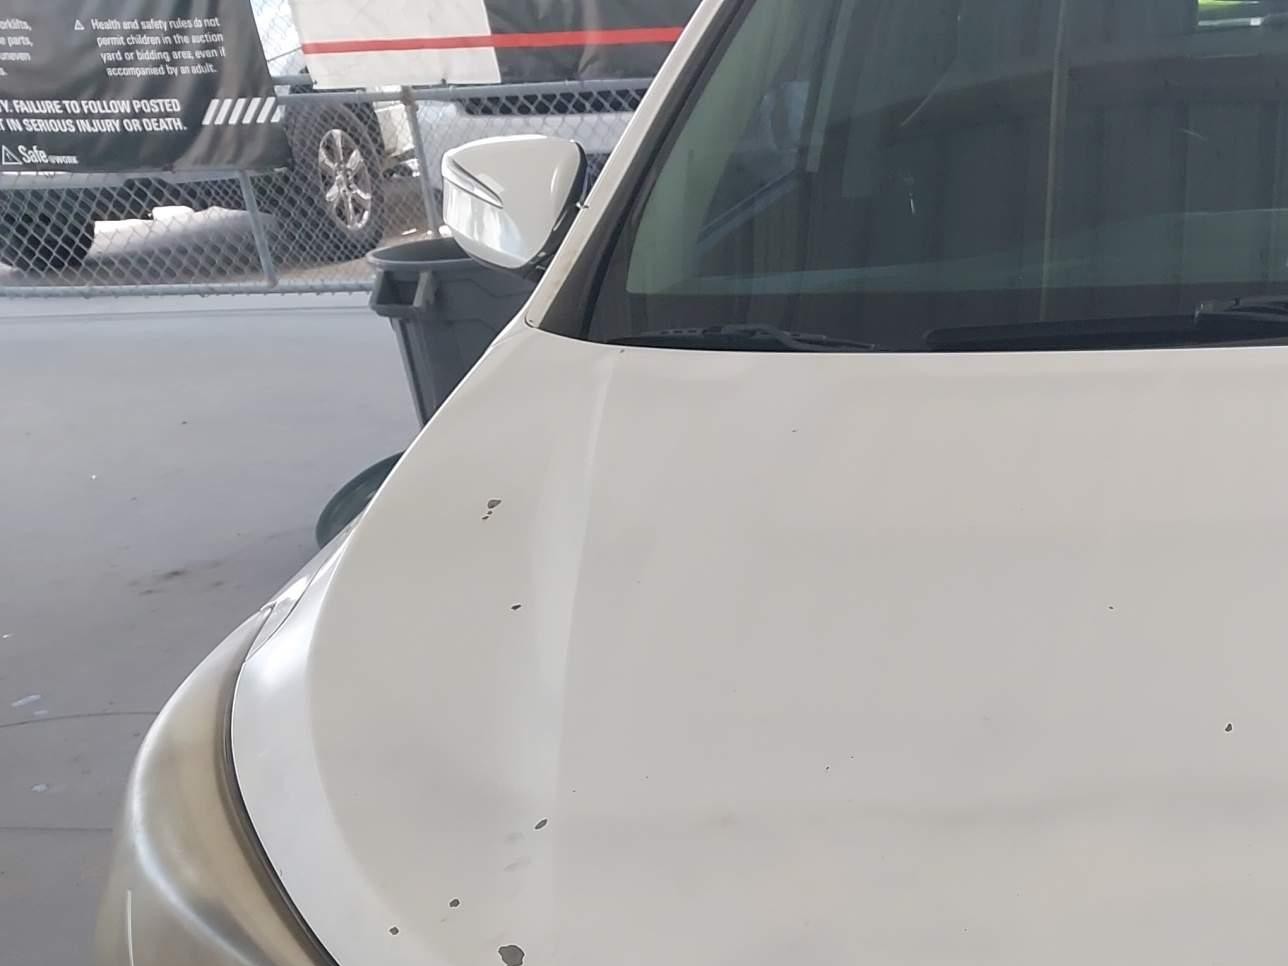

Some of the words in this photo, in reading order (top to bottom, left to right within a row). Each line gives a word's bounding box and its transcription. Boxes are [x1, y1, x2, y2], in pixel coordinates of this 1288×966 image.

[91, 18, 120, 30] Health
[122, 19, 139, 30] and
[141, 19, 167, 31] safety
[169, 17, 192, 29] rules
[193, 17, 202, 28] do
[203, 17, 220, 27] not
[8, 36, 34, 47] parts,
[96, 35, 126, 48] permit
[126, 34, 161, 46] children
[162, 34, 172, 45] in
[173, 34, 190, 44] the
[191, 33, 224, 43] auction
[100, 49, 121, 64] yard
[124, 51, 135, 61] or
[135, 49, 170, 62] bidding
[194, 48, 217, 59] even
[219, 46, 226, 58] if
[106, 64, 165, 77] accompanied
[165, 63, 178, 76] by
[180, 65, 190, 74] an
[191, 62, 218, 73] adult.
[12, 99, 63, 114] FAILURE
[62, 99, 80, 114] TO
[81, 99, 130, 113] FOLLOW
[132, 98, 181, 113] POSTED
[6, 118, 23, 131] IN
[22, 118, 76, 132] SERIOUS
[76, 118, 121, 132] INJURY
[122, 118, 143, 132] OR
[142, 117, 188, 131] DEATH.
